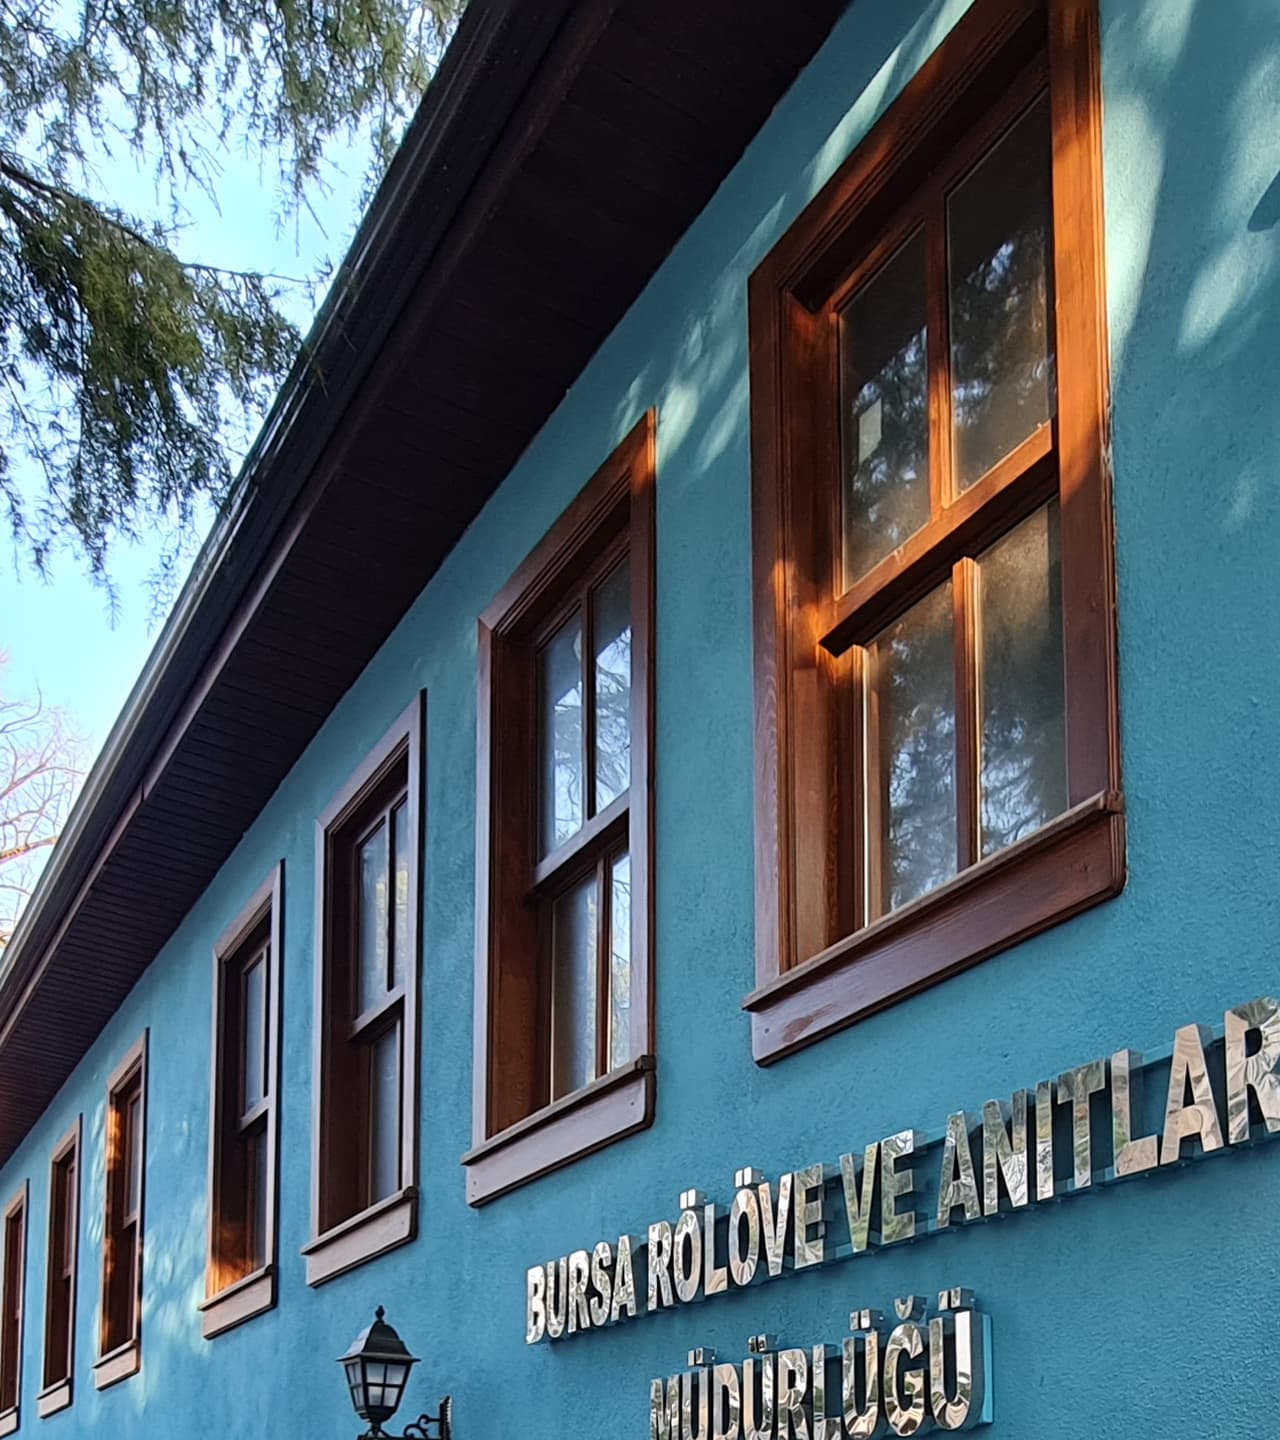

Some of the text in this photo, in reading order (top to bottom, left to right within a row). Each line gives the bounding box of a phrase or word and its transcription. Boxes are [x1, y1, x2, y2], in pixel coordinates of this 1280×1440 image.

[525, 1234, 638, 1344] BURSA
[647, 1166, 828, 1311] RÖLÖVE
[840, 1129, 921, 1252] VE
